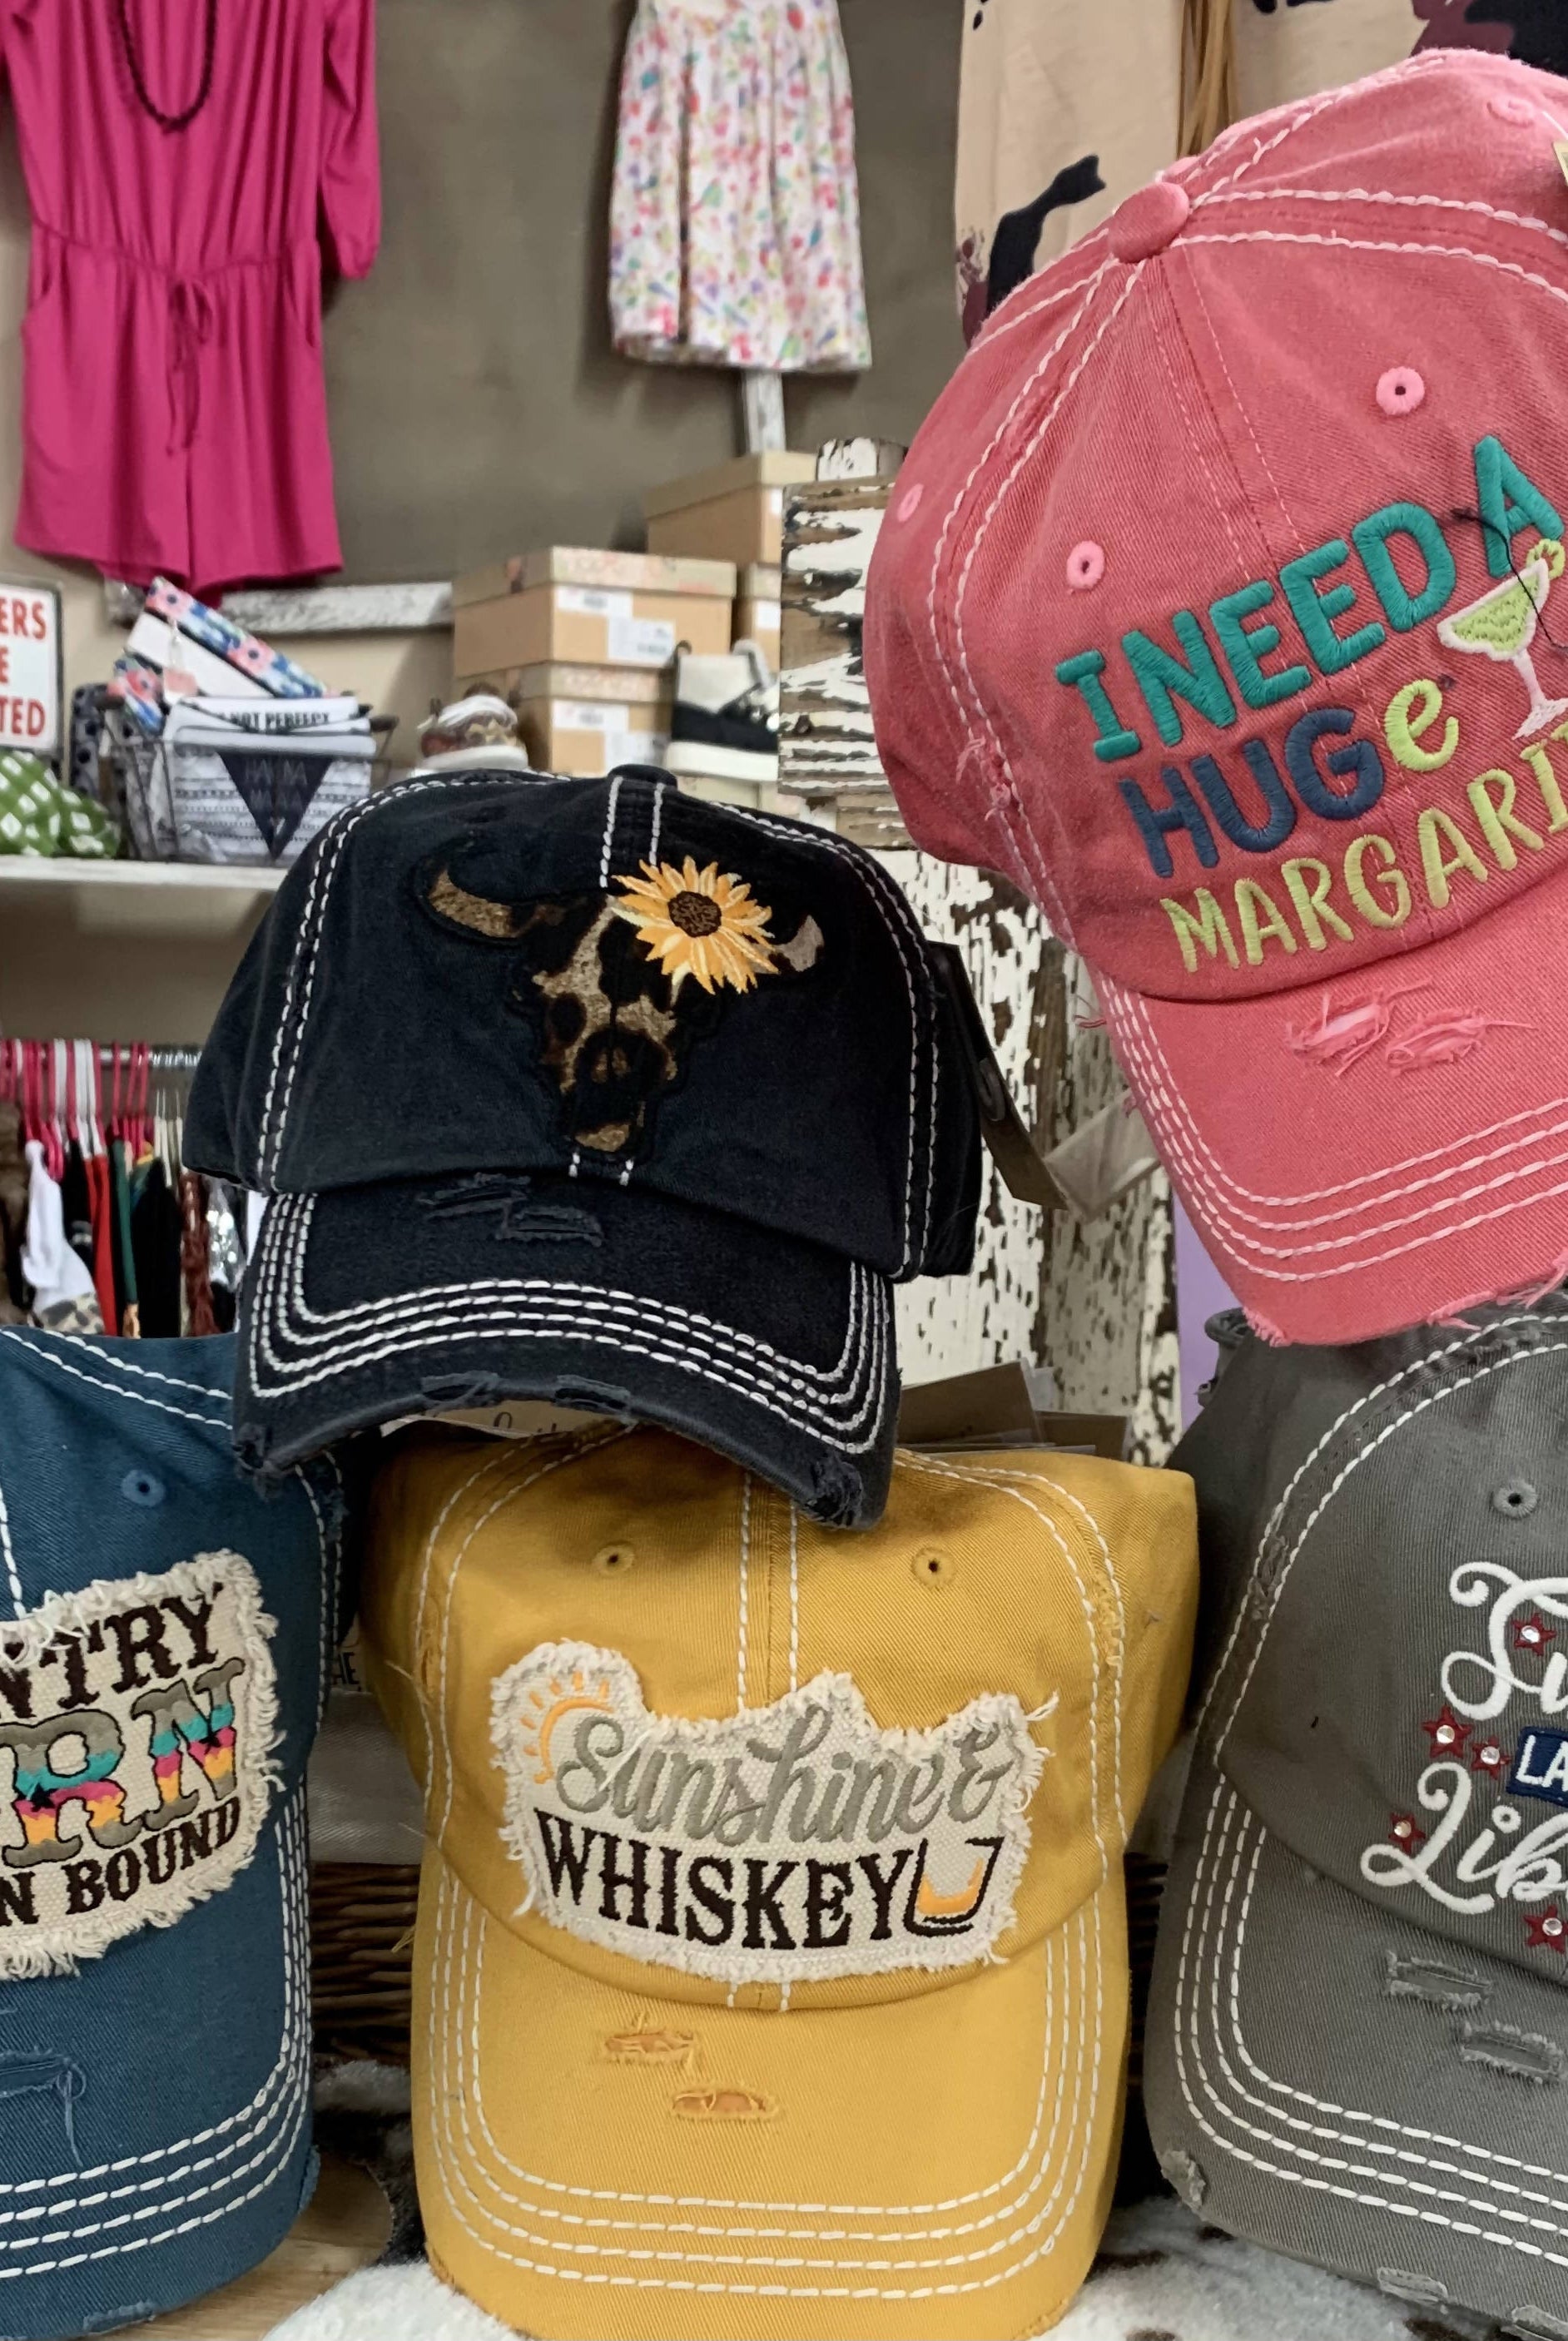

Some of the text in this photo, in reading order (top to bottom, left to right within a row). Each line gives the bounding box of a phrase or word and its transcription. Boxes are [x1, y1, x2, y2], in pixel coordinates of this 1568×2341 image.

[1055, 434, 1563, 762] I NEED A
[1159, 721, 1568, 973] MARGARI
[557, 1704, 946, 1848] Sunshine
[61, 1797, 241, 1915] BOUND
[533, 1808, 915, 1951] WHISKEY
